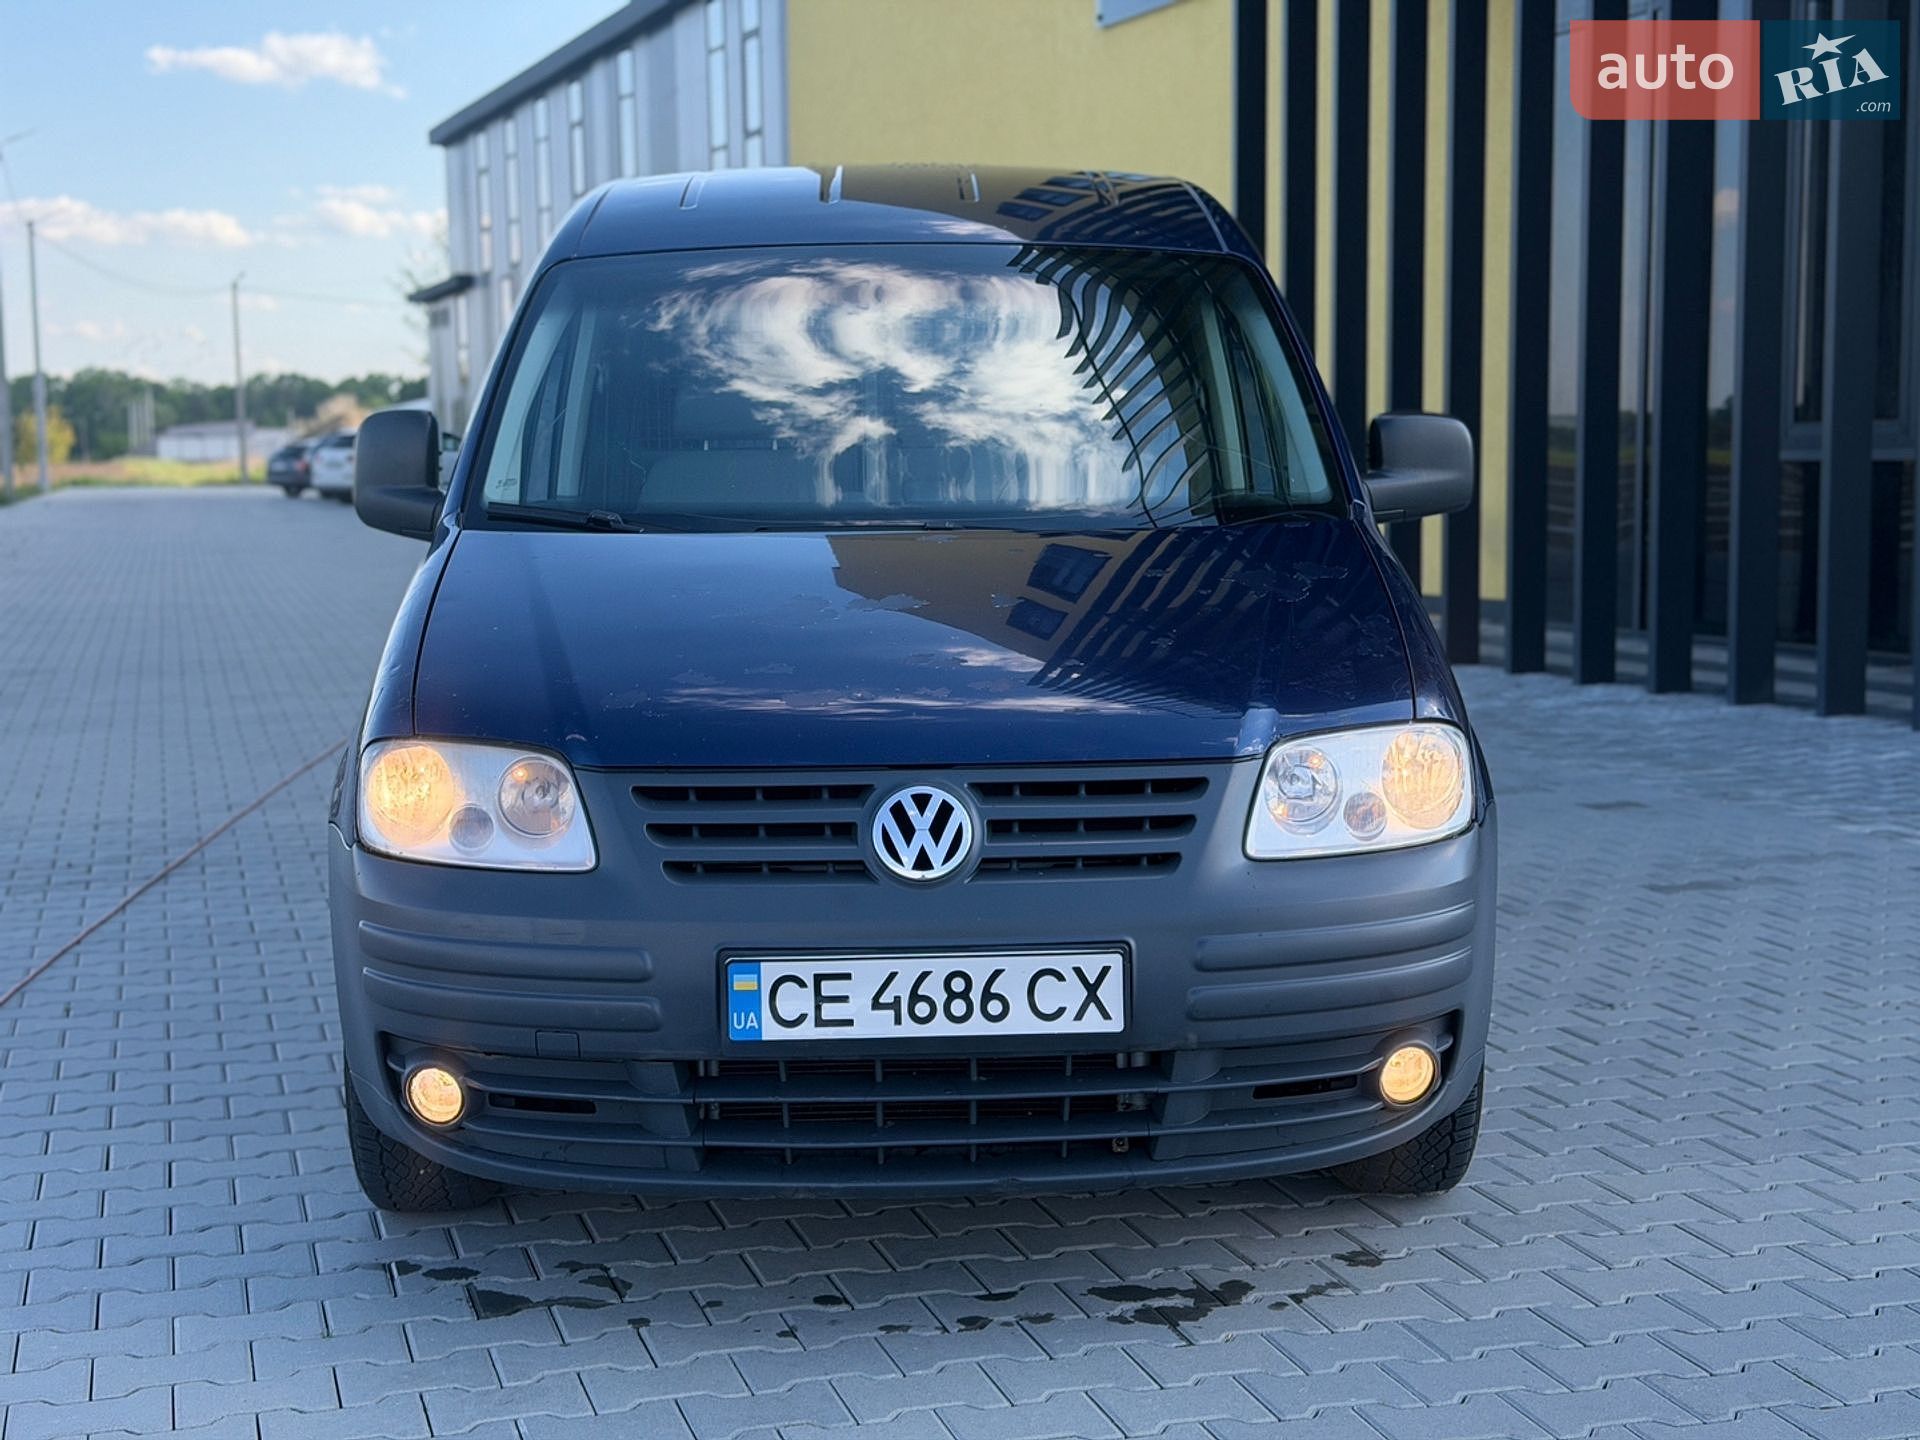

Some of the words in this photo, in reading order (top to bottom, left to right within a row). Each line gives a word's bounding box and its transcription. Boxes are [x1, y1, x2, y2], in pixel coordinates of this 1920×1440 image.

[768, 972, 855, 1029] CE
[871, 969, 1010, 1026] 4686
[1026, 965, 1113, 1023] CX
[732, 1012, 759, 1031] UA
